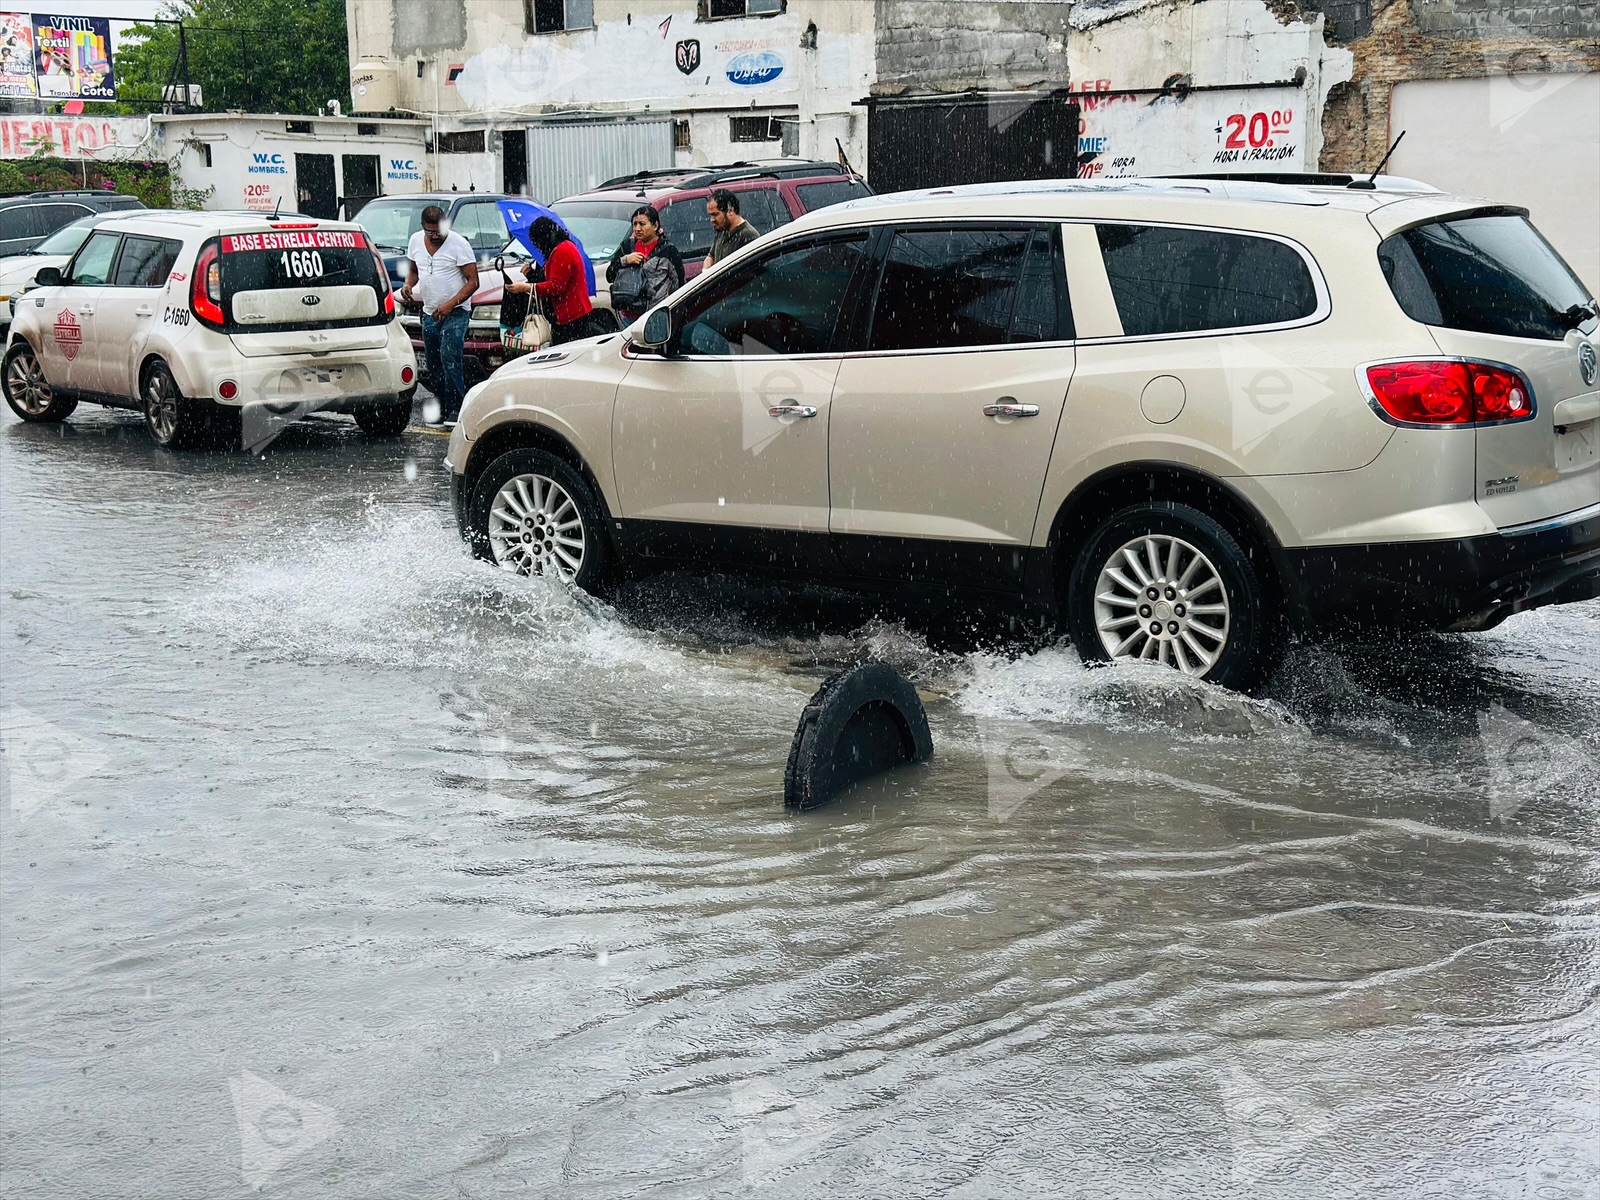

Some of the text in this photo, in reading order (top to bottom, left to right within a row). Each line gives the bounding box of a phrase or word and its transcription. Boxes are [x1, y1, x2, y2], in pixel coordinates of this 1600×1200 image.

[50, 16, 94, 32] VINIL
[35, 36, 69, 47] Textil
[3, 62, 32, 73] Piñatas
[81, 85, 114, 96] Corte
[252, 153, 285, 164] W.C.
[1212, 149, 1239, 163] HORA
[391, 159, 418, 170] W.C.
[1112, 157, 1136, 168] HORA
[248, 165, 288, 174] HOMBRES.
[387, 171, 422, 180] MUJERES.
[230, 231, 355, 252] BASE ESTRELLA CENTRO
[281, 250, 324, 278] 1660
[164, 306, 190, 327] C-1660
